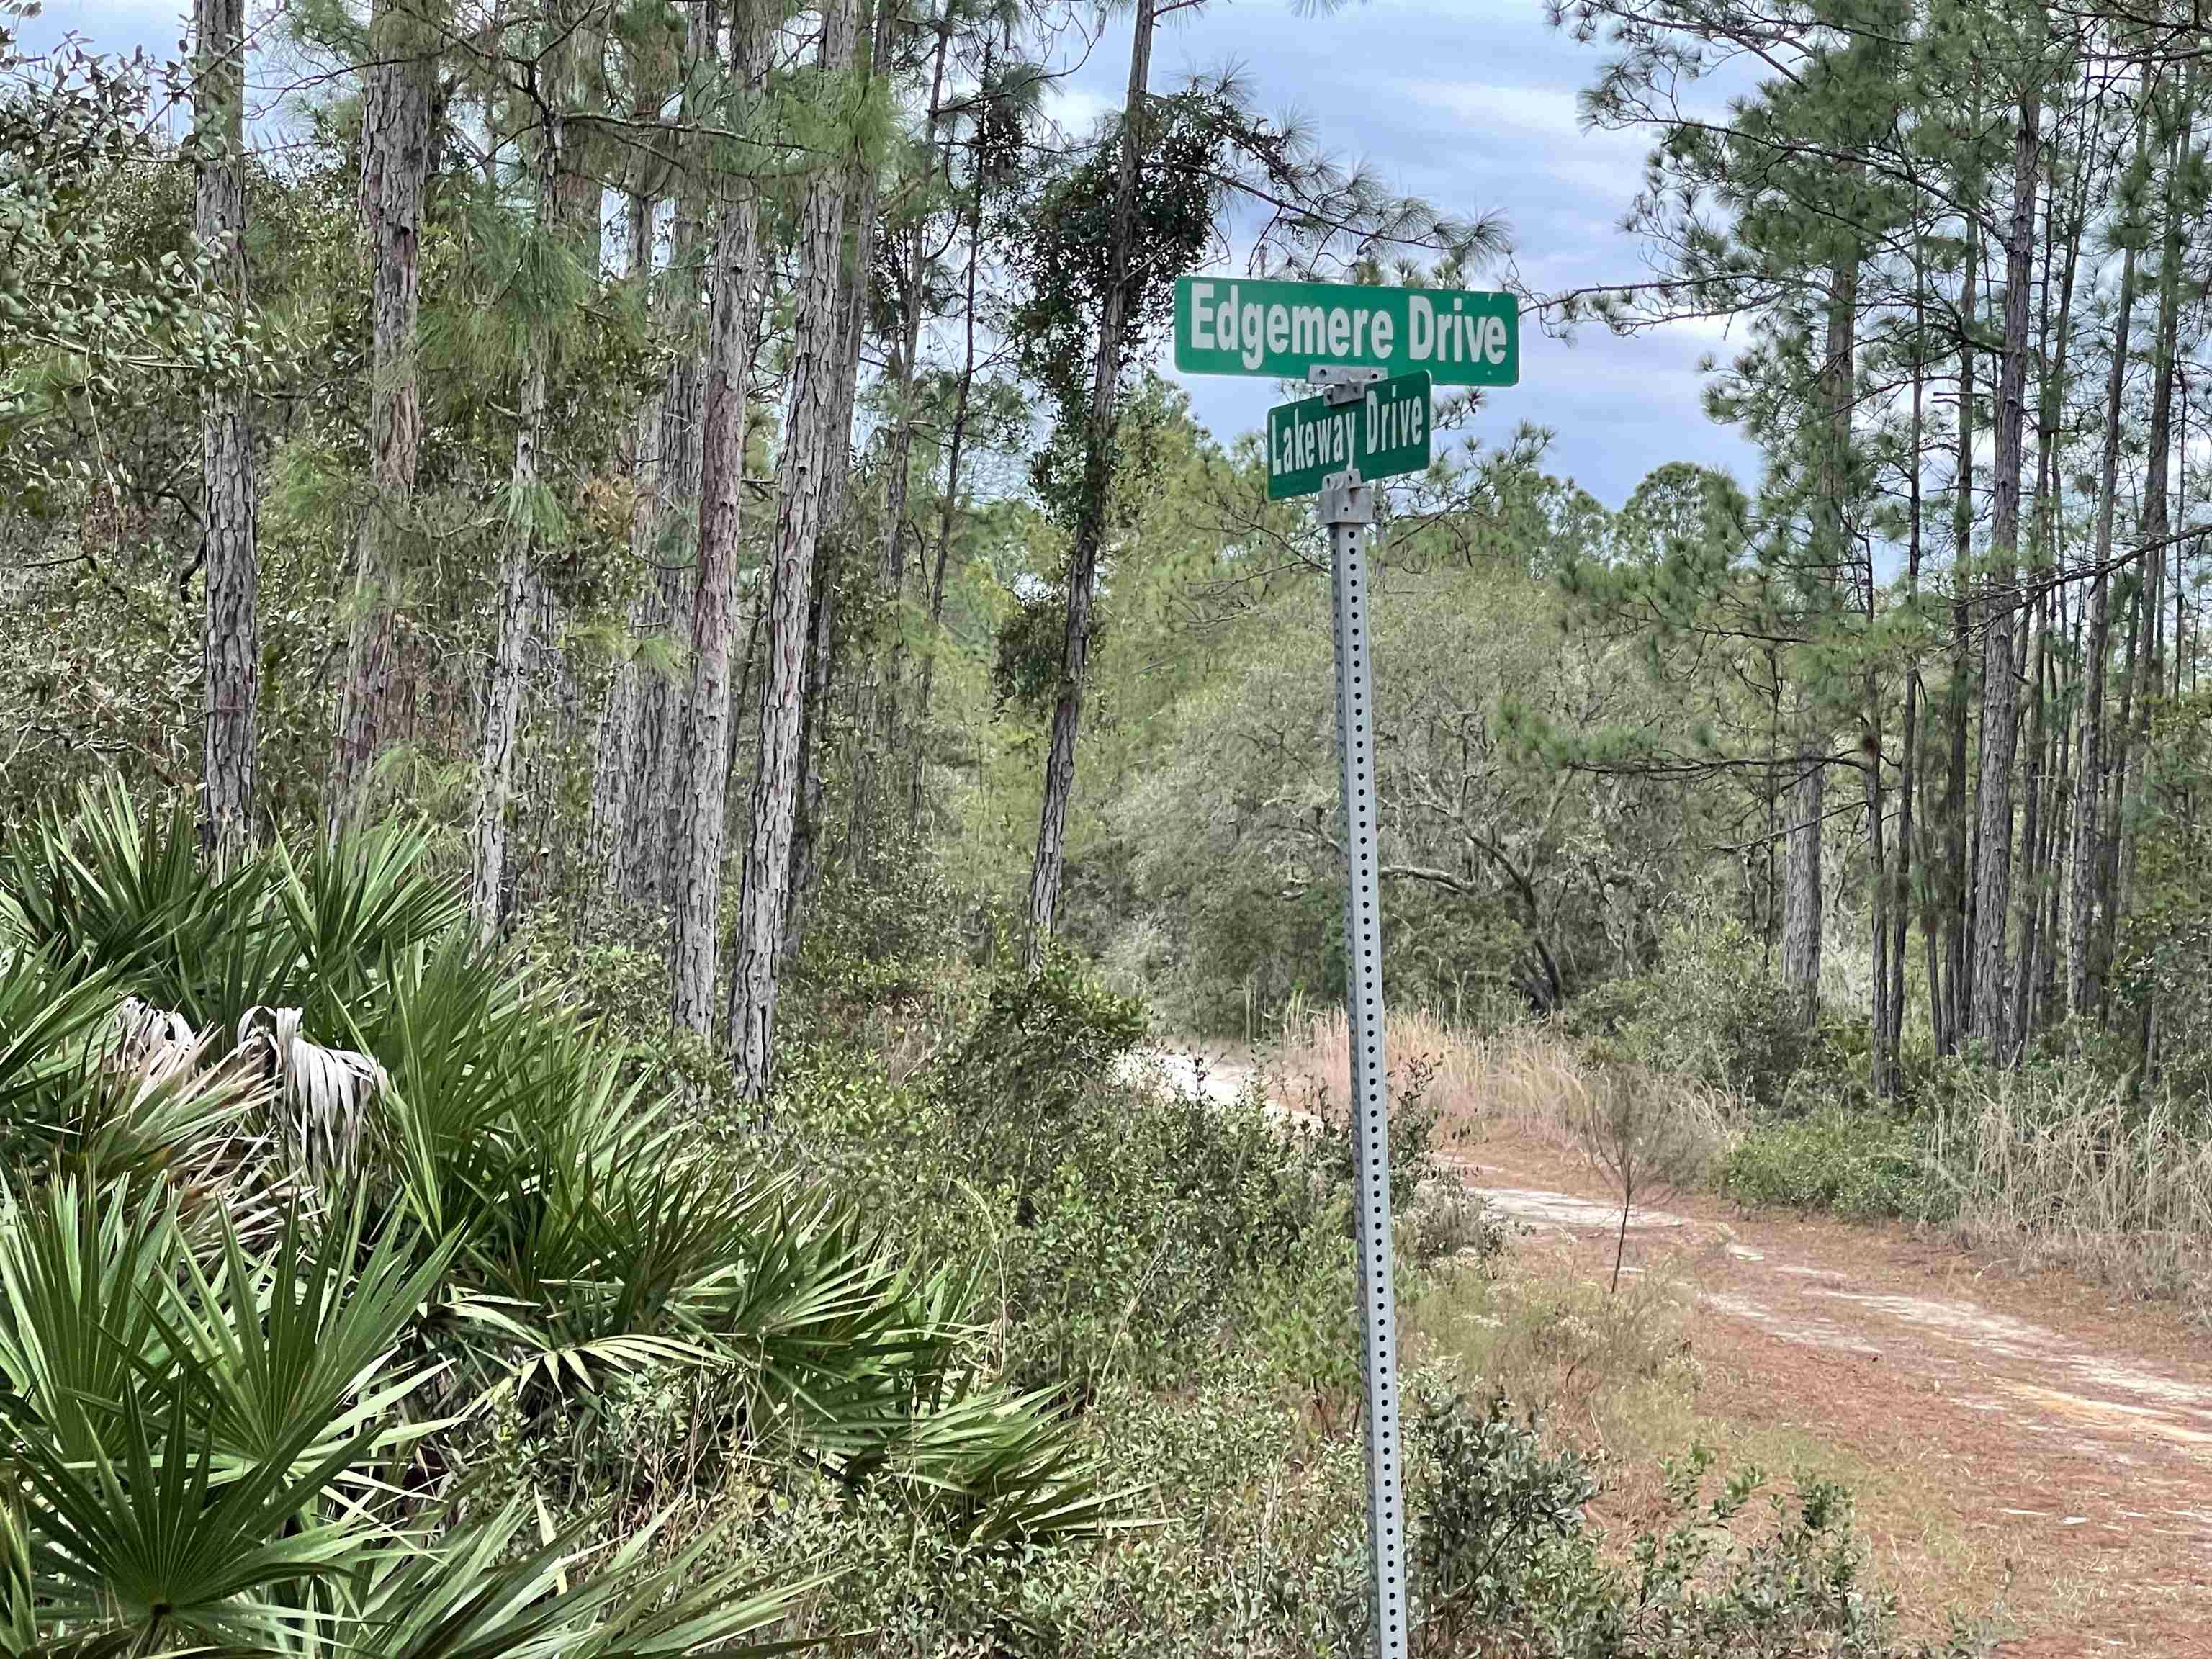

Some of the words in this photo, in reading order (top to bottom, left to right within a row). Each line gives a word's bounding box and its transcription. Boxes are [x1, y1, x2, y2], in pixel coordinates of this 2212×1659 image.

[1190, 282, 1394, 369] Edgemere
[1408, 295, 1507, 364] Drive
[1272, 408, 1356, 475] Lakeway
[1366, 385, 1423, 454] Drive
